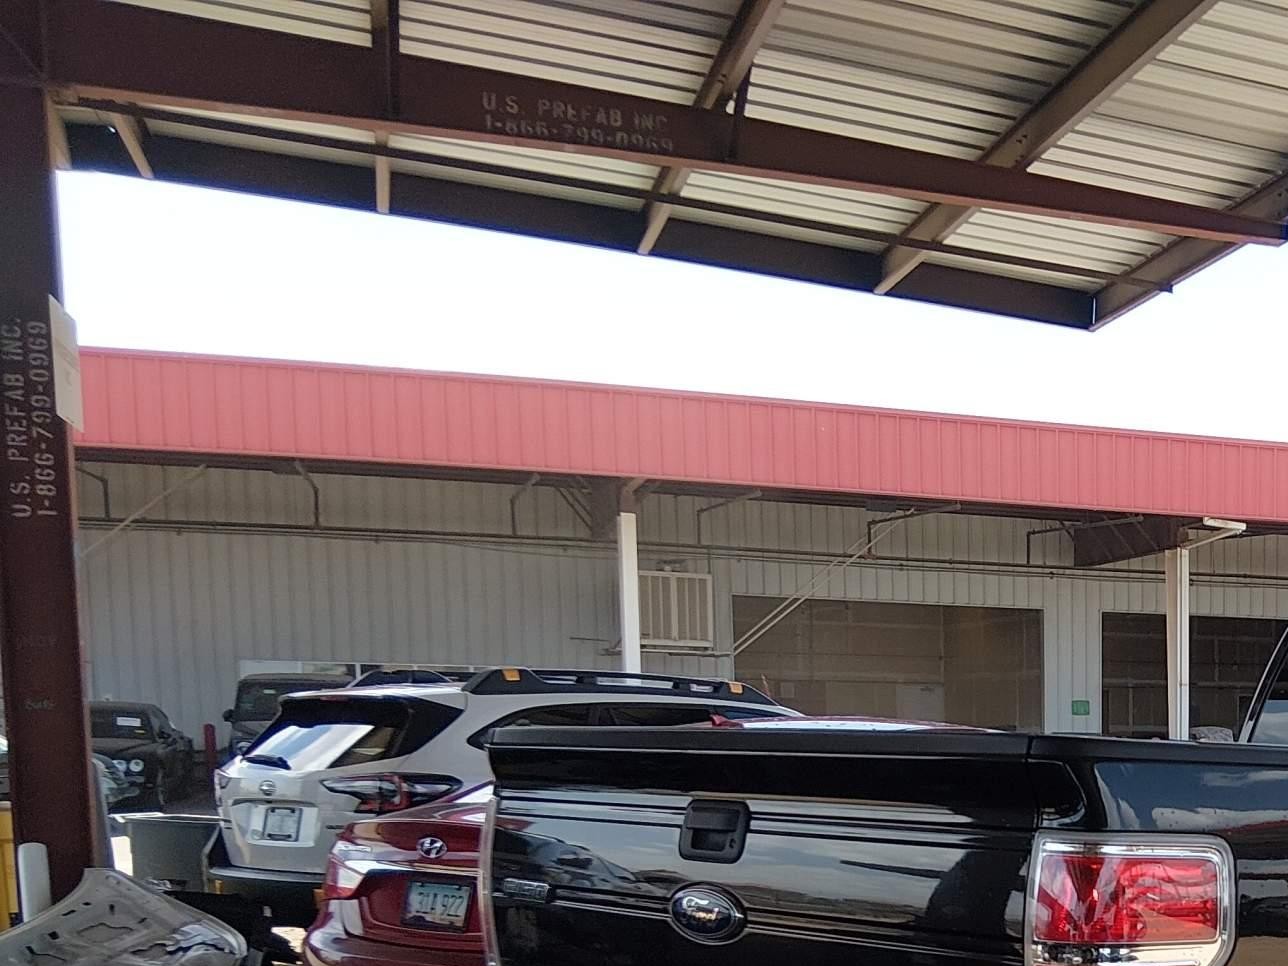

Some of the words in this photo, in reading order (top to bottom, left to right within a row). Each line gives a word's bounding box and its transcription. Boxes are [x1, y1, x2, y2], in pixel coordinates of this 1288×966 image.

[482, 91, 526, 115] U.S.
[537, 99, 622, 128] PREFAB
[1, 318, 24, 361] INC.
[3, 374, 29, 461] PREFAB
[27, 320, 58, 516] 1-866-799-0969
[9, 476, 33, 518] U.S.
